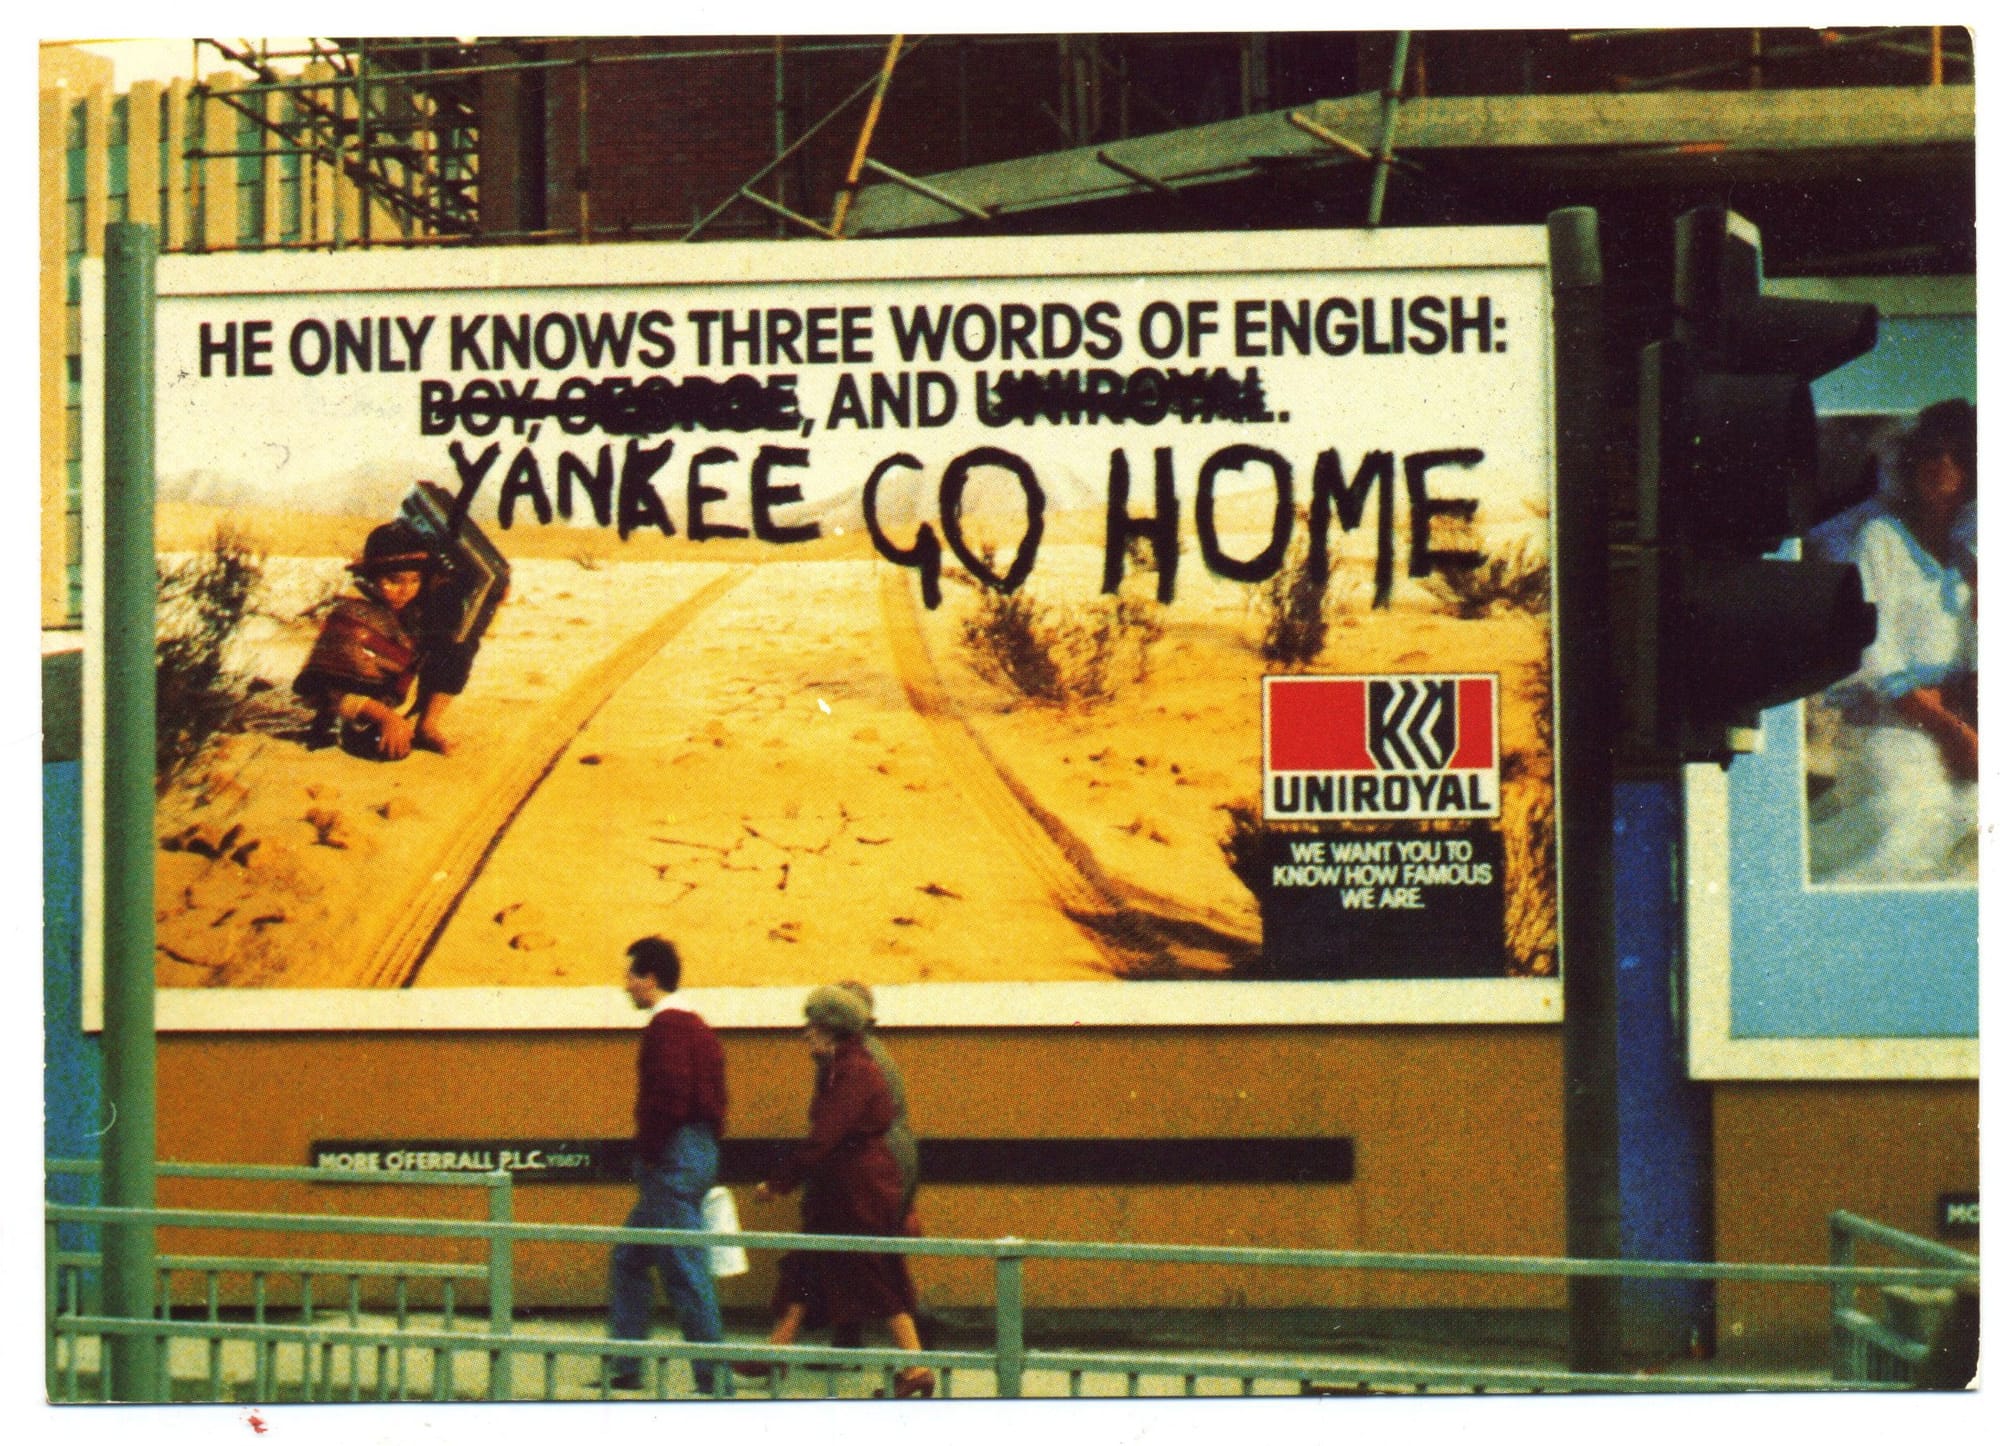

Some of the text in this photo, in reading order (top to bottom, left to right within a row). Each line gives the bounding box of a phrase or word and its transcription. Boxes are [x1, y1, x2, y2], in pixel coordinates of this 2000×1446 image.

[200, 296, 1508, 377] HE ONLY KNOWS THREE WORDS OF ENGLISH:
[826, 371, 957, 430] AND
[447, 439, 1485, 610] YANKEE GO HOME
[1273, 773, 1492, 813] UNIROYAL
[1290, 840, 1473, 863] WE WANT YOU TO
[1273, 863, 1493, 886] KNOW HOW FAMOUS
[1341, 888, 1375, 909] WE
[318, 1152, 381, 1172] MORE
